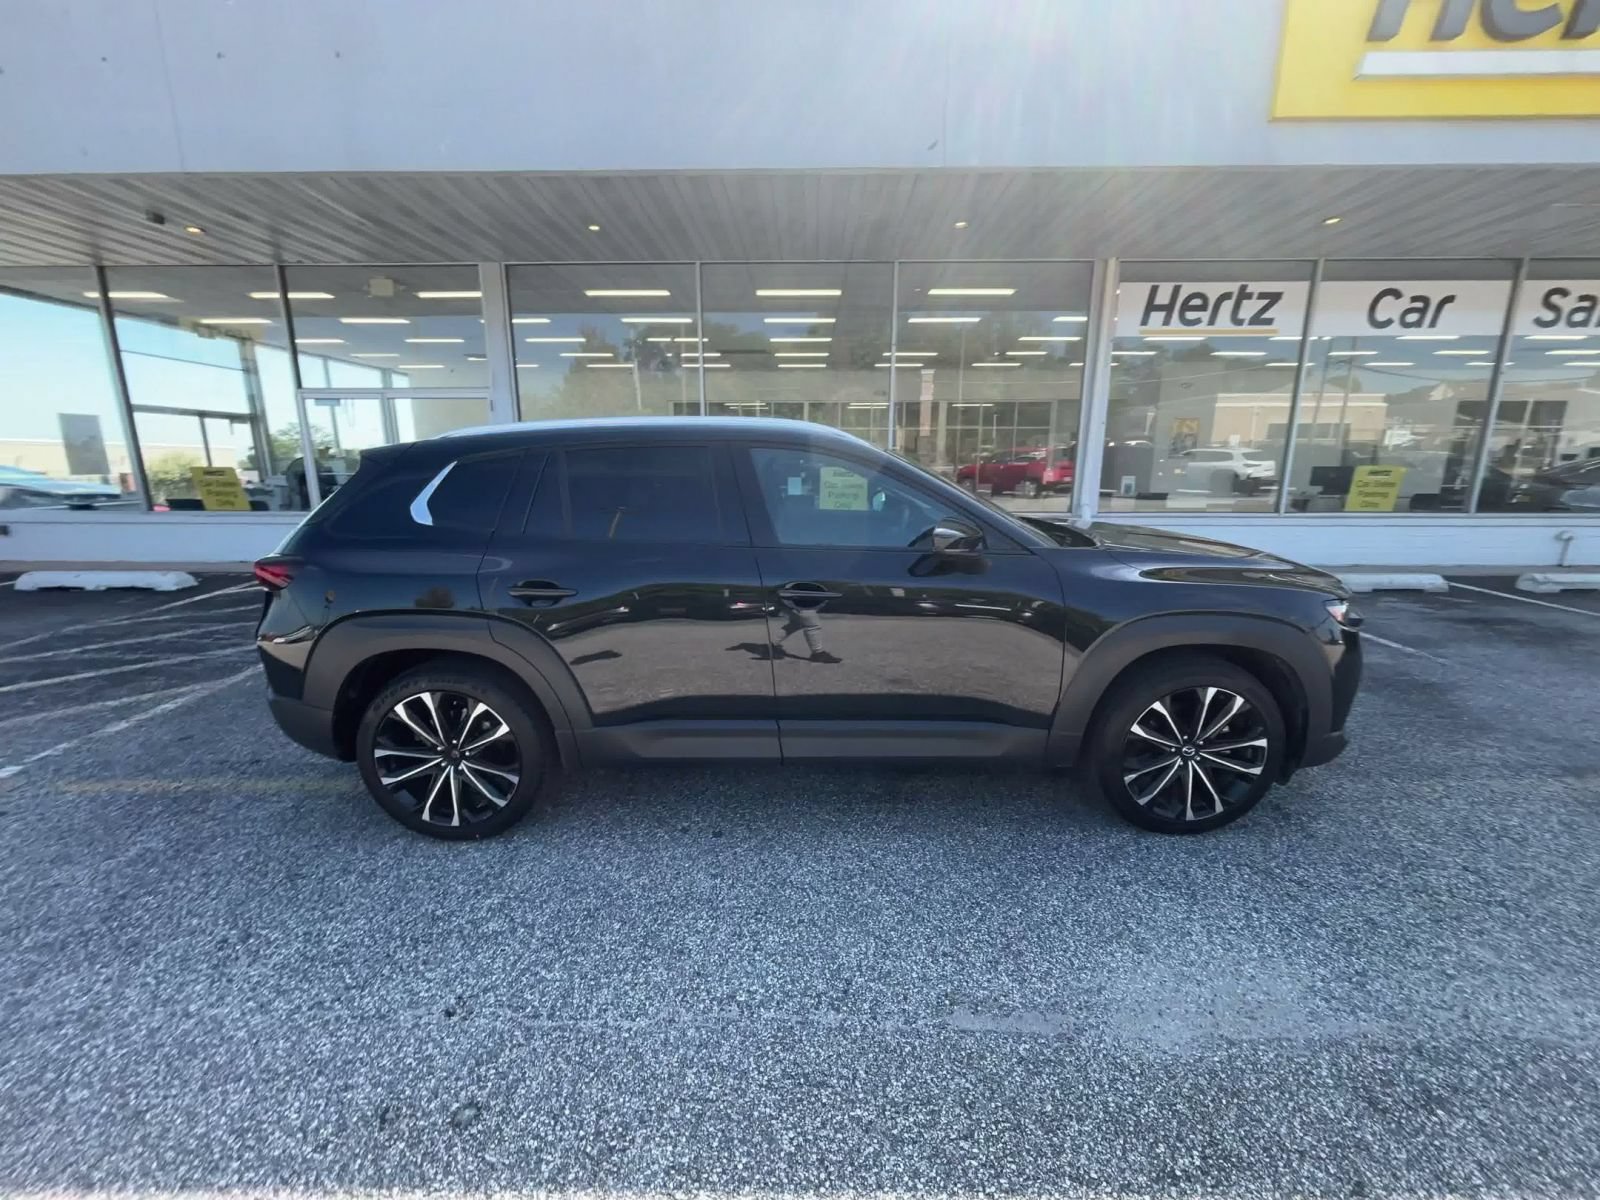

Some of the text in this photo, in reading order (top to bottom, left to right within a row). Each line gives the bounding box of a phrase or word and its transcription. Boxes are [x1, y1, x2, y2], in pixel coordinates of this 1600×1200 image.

[1140, 284, 1600, 329] Hertz Car Sa
